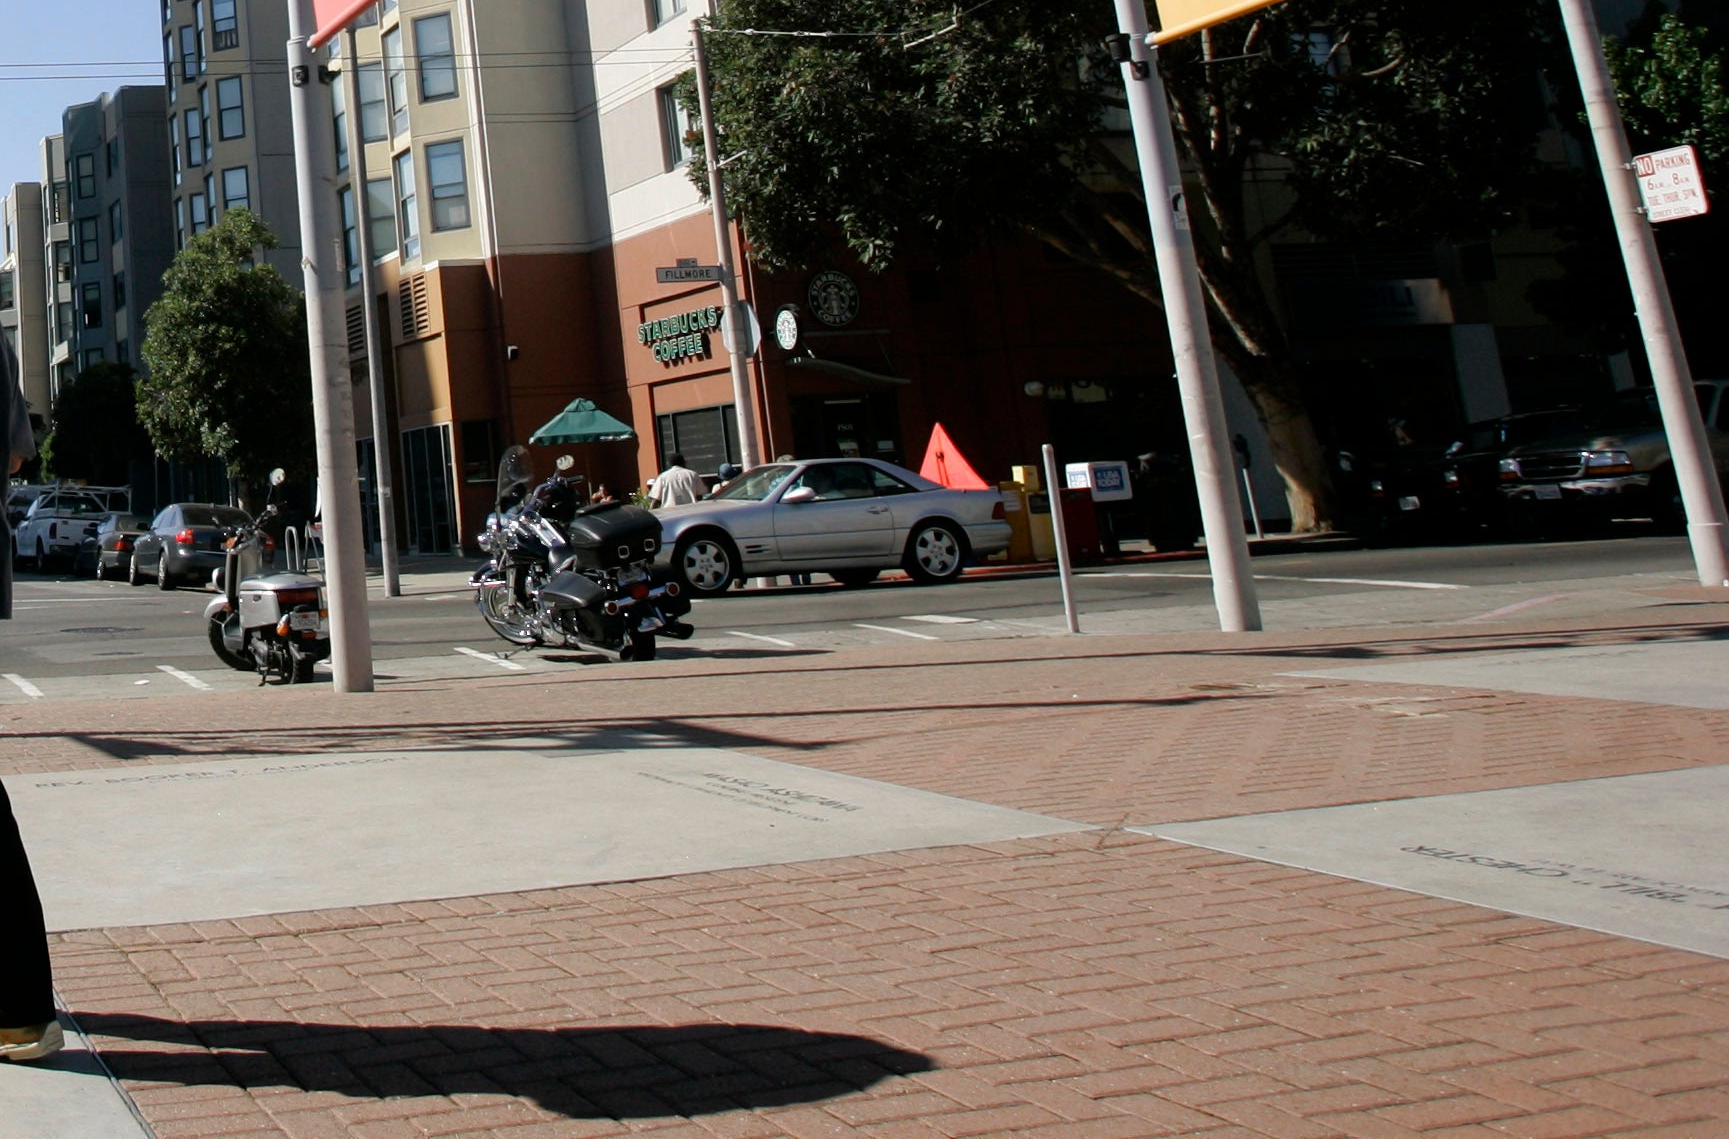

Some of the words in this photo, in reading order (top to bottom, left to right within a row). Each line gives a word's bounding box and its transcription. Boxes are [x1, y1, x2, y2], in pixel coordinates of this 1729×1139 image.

[1636, 156, 1653, 175] NO
[1655, 152, 1691, 171] PARKING
[665, 269, 712, 280] FILLMORE
[810, 273, 856, 297] STARBUCKS
[637, 304, 718, 345] STARBUCKS
[652, 332, 704, 364] COFFEE
[105, 771, 215, 783] BOOKER
[1399, 844, 1571, 878] CHESTER
